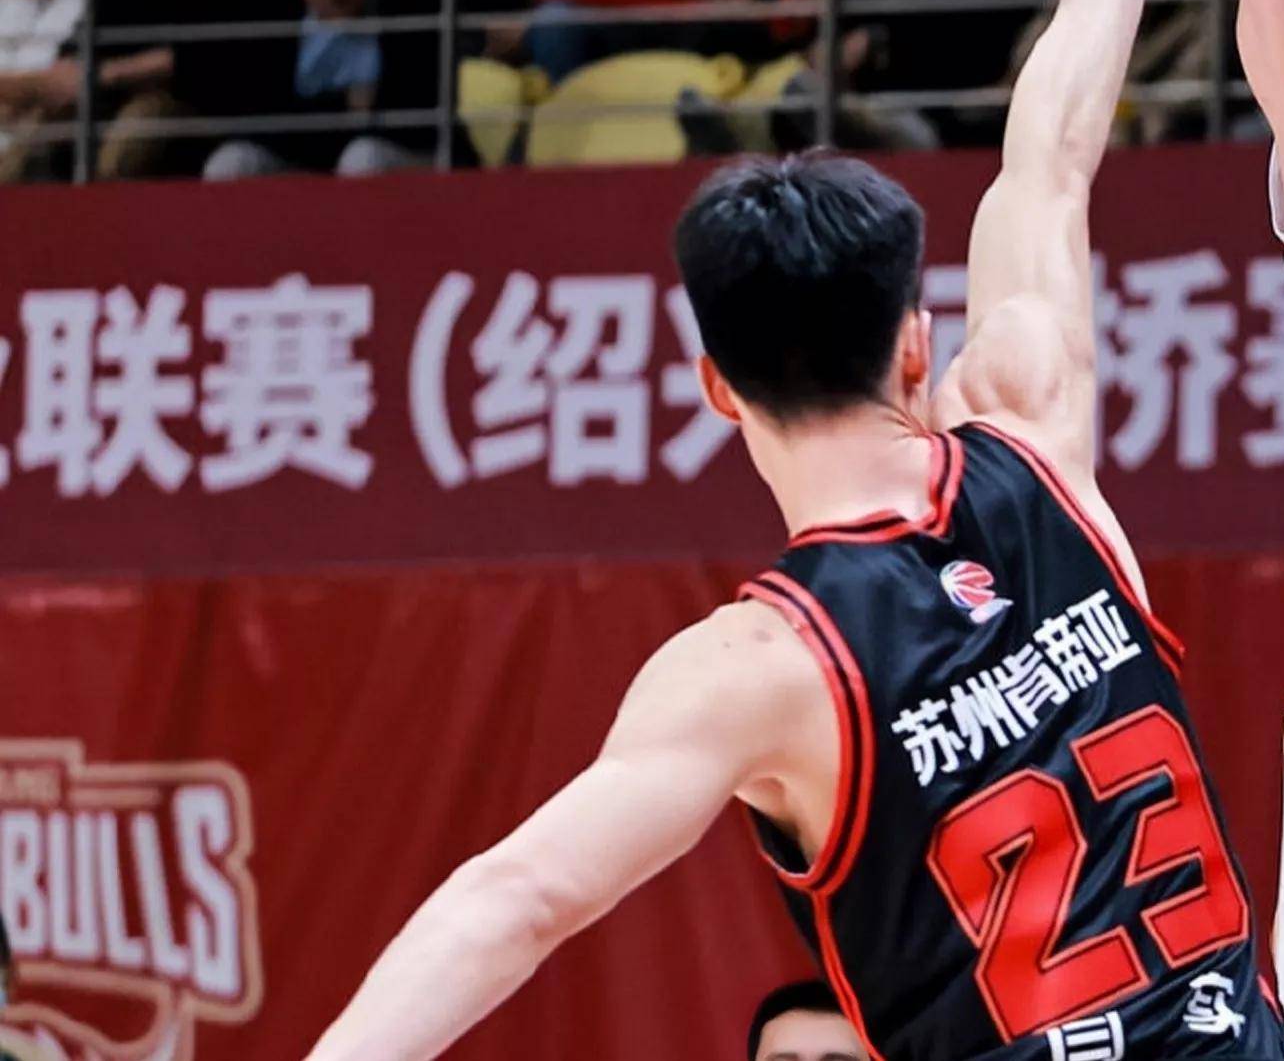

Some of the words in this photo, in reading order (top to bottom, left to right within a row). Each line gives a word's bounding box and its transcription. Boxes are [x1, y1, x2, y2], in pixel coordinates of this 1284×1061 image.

[891, 588, 1142, 787] 苏州肯帝亚
[0, 785, 240, 995] BULLS
[926, 703, 1250, 1044] 23
